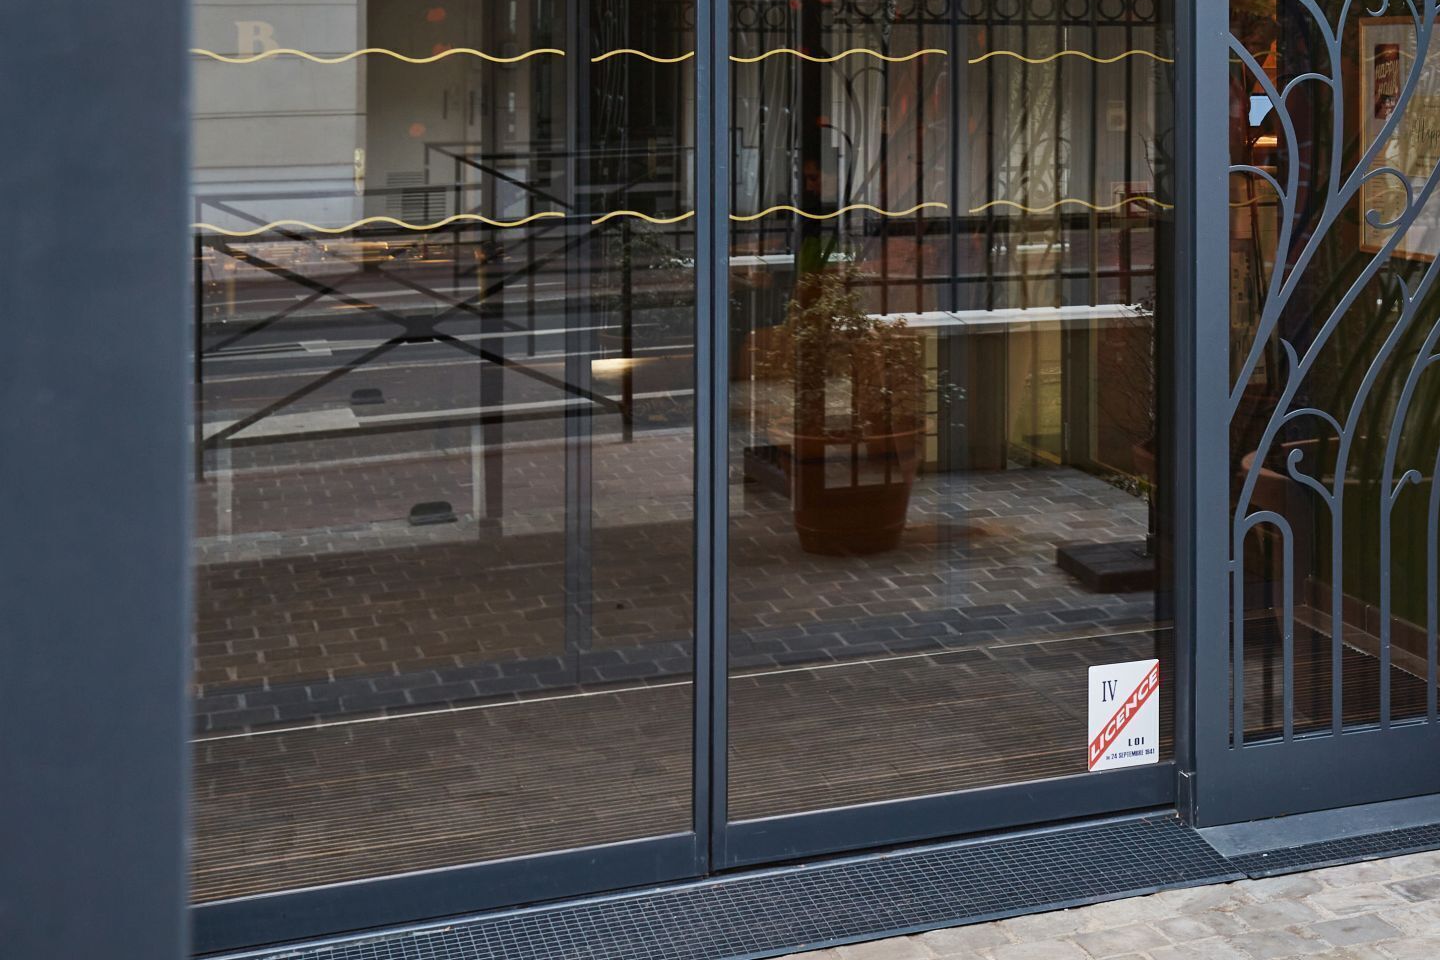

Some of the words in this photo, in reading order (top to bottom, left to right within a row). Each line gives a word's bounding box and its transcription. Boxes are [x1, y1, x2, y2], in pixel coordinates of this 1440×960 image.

[1102, 679, 1118, 702] IV
[1089, 667, 1158, 762] LICENCE
[1128, 736, 1145, 746] LOI
[1118, 750, 1144, 759] SEPTEMBRE
